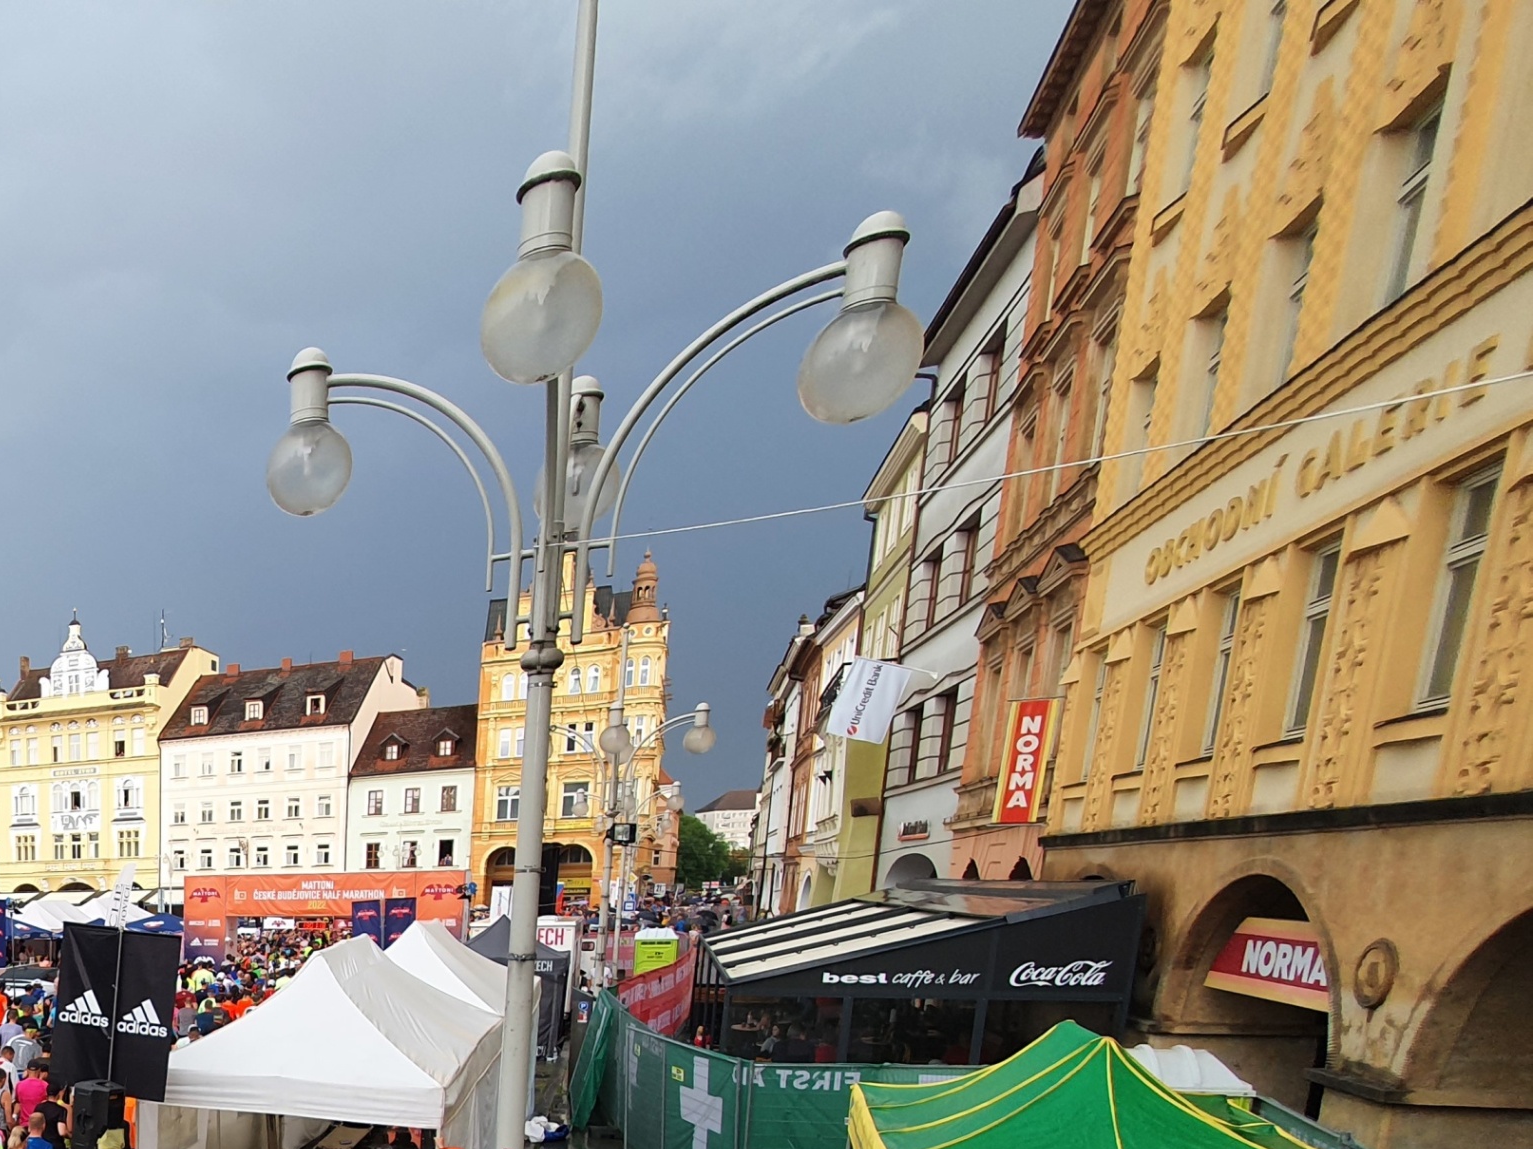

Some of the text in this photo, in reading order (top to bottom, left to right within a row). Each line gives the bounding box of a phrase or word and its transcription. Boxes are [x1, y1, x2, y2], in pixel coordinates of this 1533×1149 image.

[1144, 333, 1501, 586] OBCHODNÍ GALERIE
[849, 664, 883, 726] UniCredit Bank
[1006, 715, 1042, 808] NORMA
[277, 887, 321, 900] BUDĚJOVICE
[322, 890, 342, 899] HALF
[343, 889, 385, 899] MARATHON
[301, 880, 334, 890] MATTONI
[308, 900, 326, 909] 2022
[1241, 939, 1328, 987] NORMA
[822, 969, 981, 988] best caffe & bar
[1009, 960, 1113, 987] Coca-Cola
[59, 1011, 109, 1027] adidas
[117, 1021, 167, 1037] adidas
